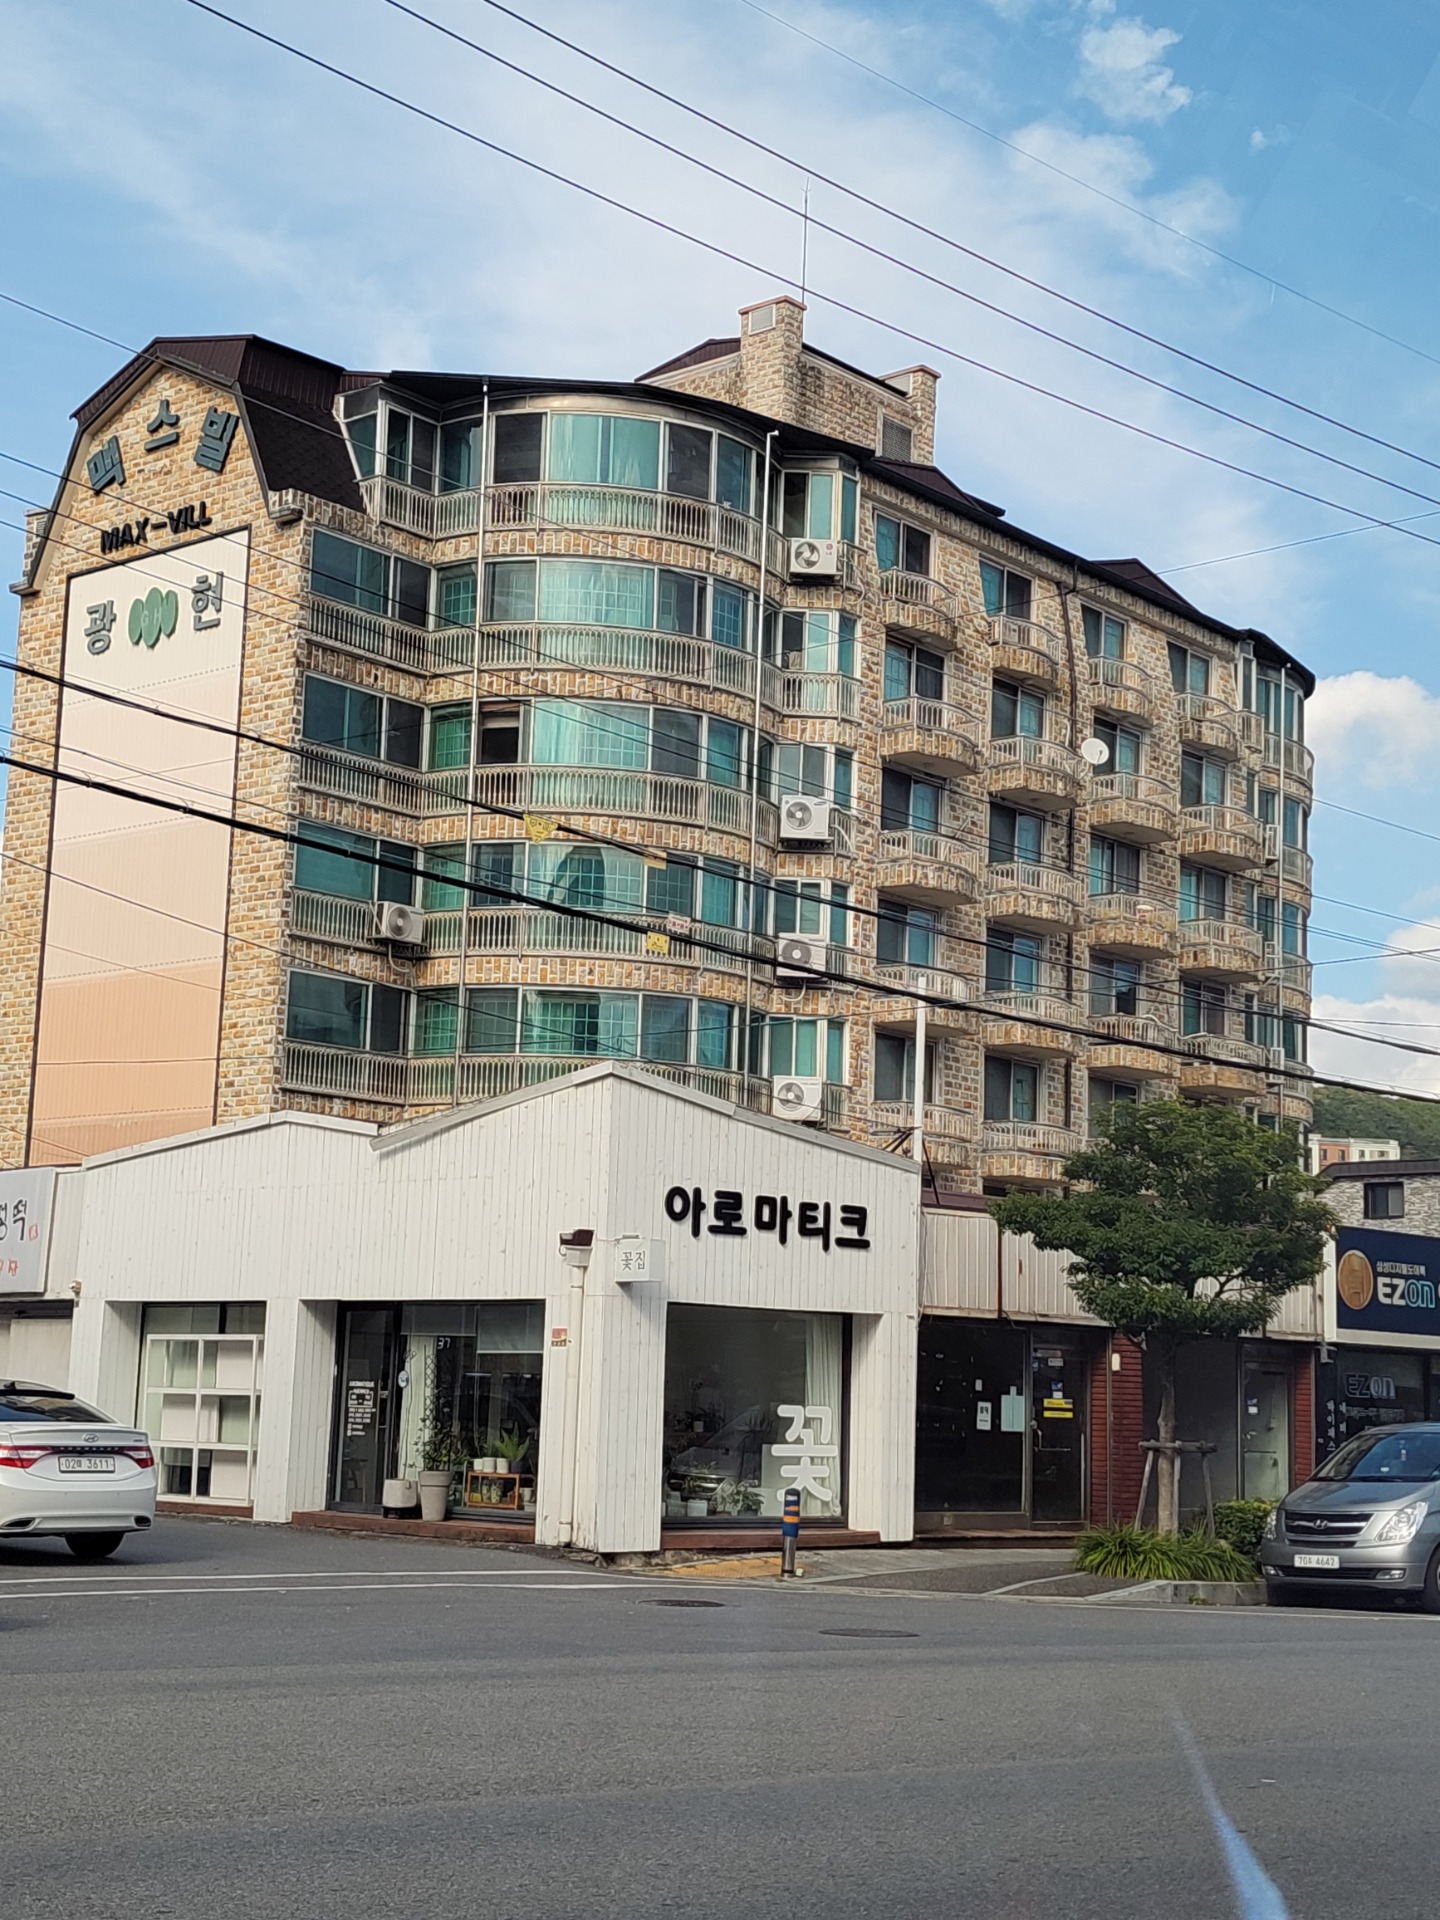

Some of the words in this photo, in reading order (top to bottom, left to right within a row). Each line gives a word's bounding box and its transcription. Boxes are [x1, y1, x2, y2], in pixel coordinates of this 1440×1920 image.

[86, 399, 240, 495] 맥스빌
[100, 501, 213, 555] MAX-VILL
[664, 1185, 871, 1252] 아로마티크
[621, 1250, 646, 1271] 꽃집
[87, 1458, 109, 1469] 3611
[771, 1404, 838, 1501] 꽃
